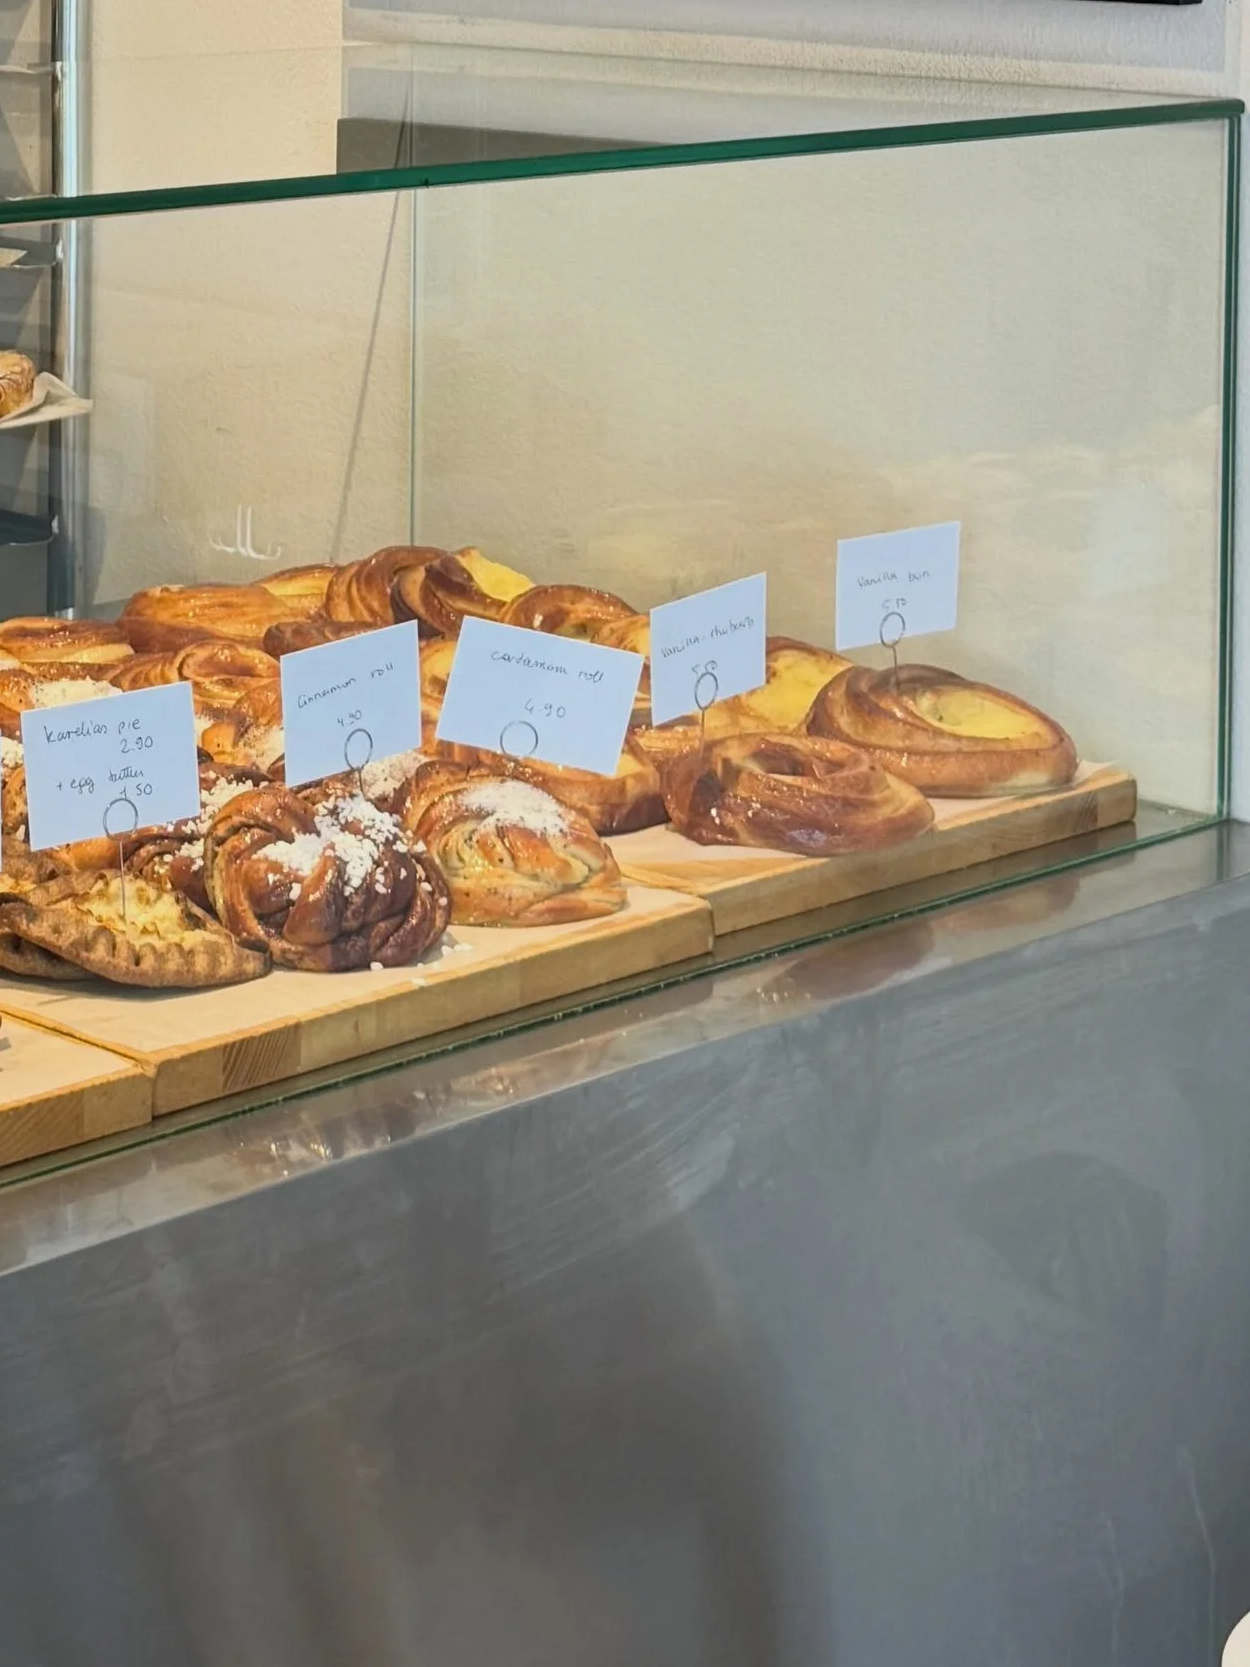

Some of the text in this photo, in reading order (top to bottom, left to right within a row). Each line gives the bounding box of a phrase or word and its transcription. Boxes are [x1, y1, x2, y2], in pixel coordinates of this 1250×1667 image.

[908, 570, 931, 583] bun
[370, 661, 394, 679] roll
[578, 669, 605, 684] roll
[118, 718, 142, 734] pie
[120, 735, 154, 754] 2.90
